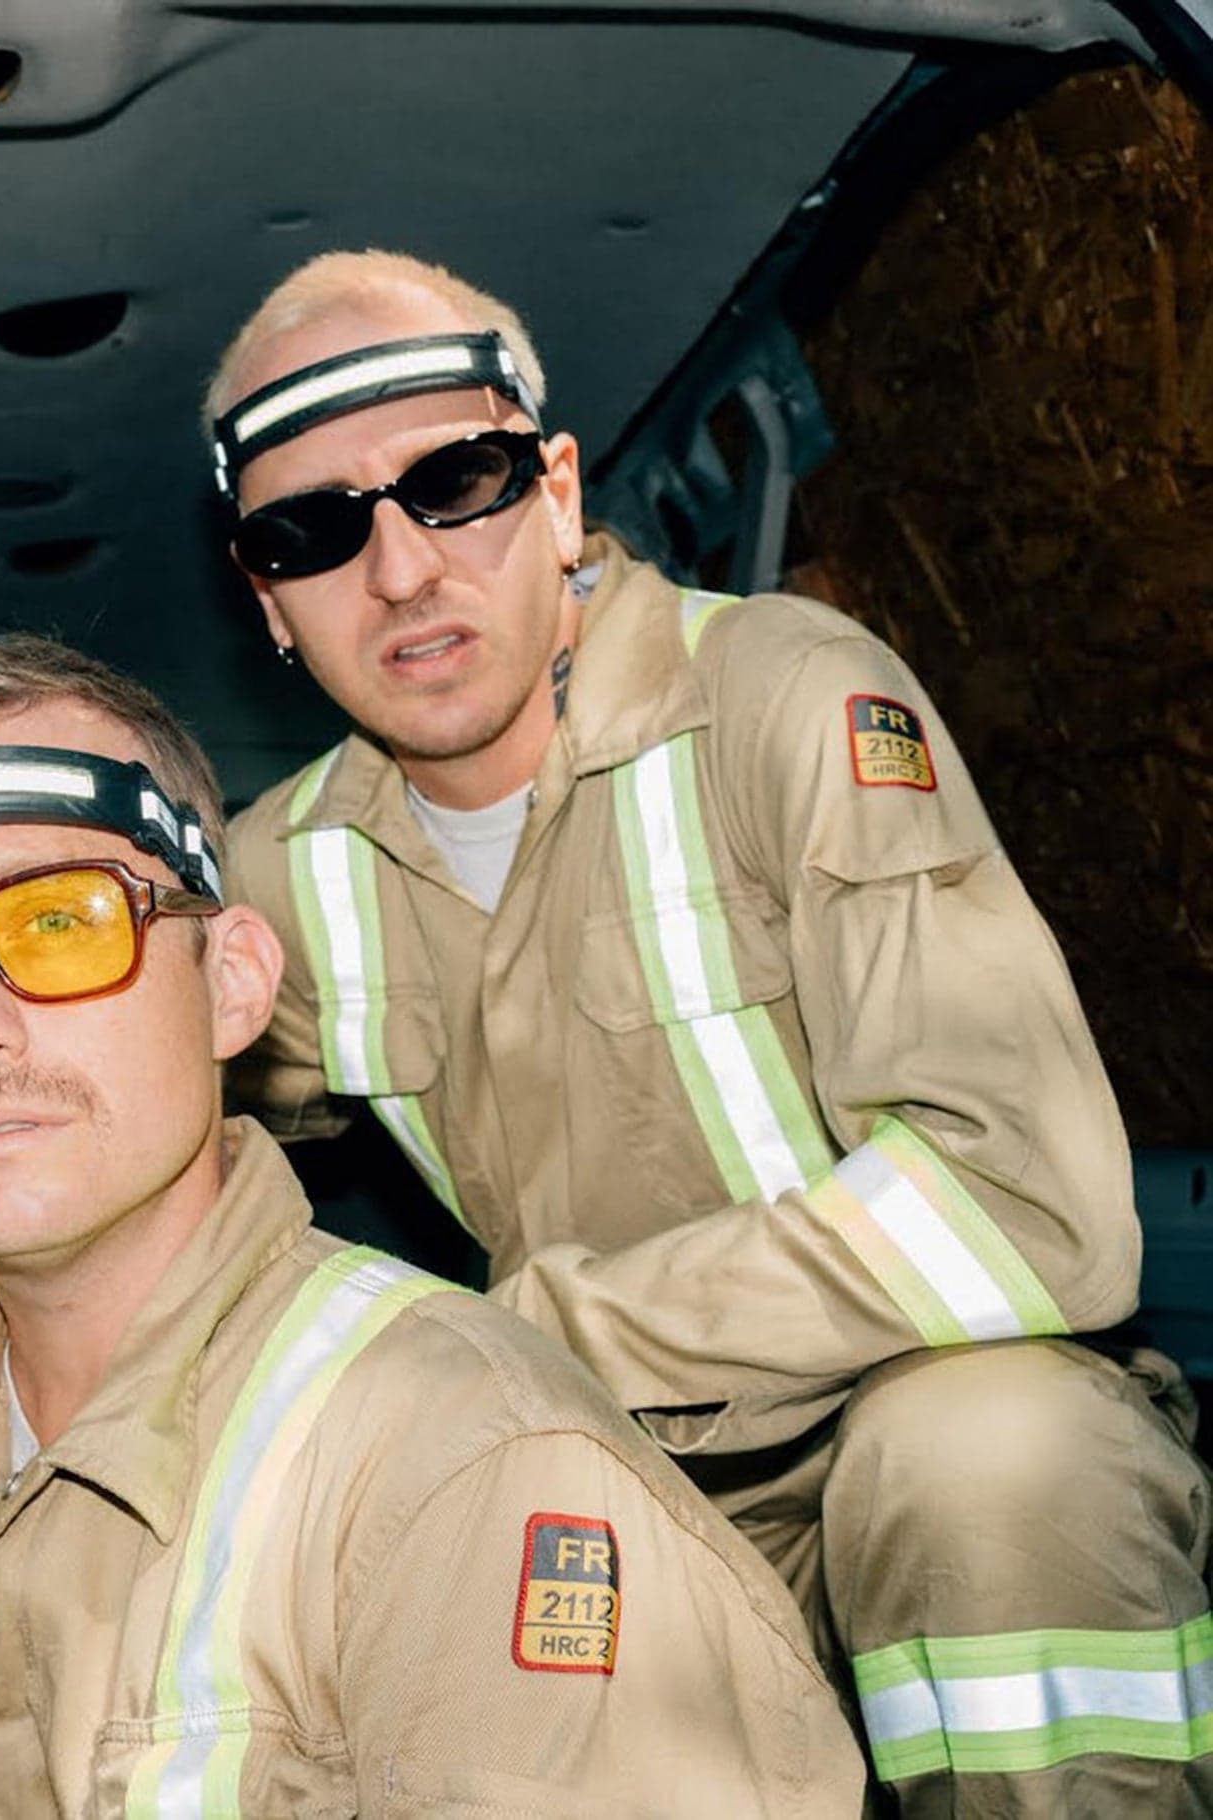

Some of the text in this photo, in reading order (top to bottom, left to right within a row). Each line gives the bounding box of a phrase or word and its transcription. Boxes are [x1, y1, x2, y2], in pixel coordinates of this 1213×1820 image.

[869, 703, 909, 734] FR
[867, 738, 919, 762] 2112
[872, 763, 909, 778] HRC
[556, 1536, 612, 1575] FR
[539, 1590, 615, 1624] 2112
[539, 1634, 612, 1660] HRC 2
